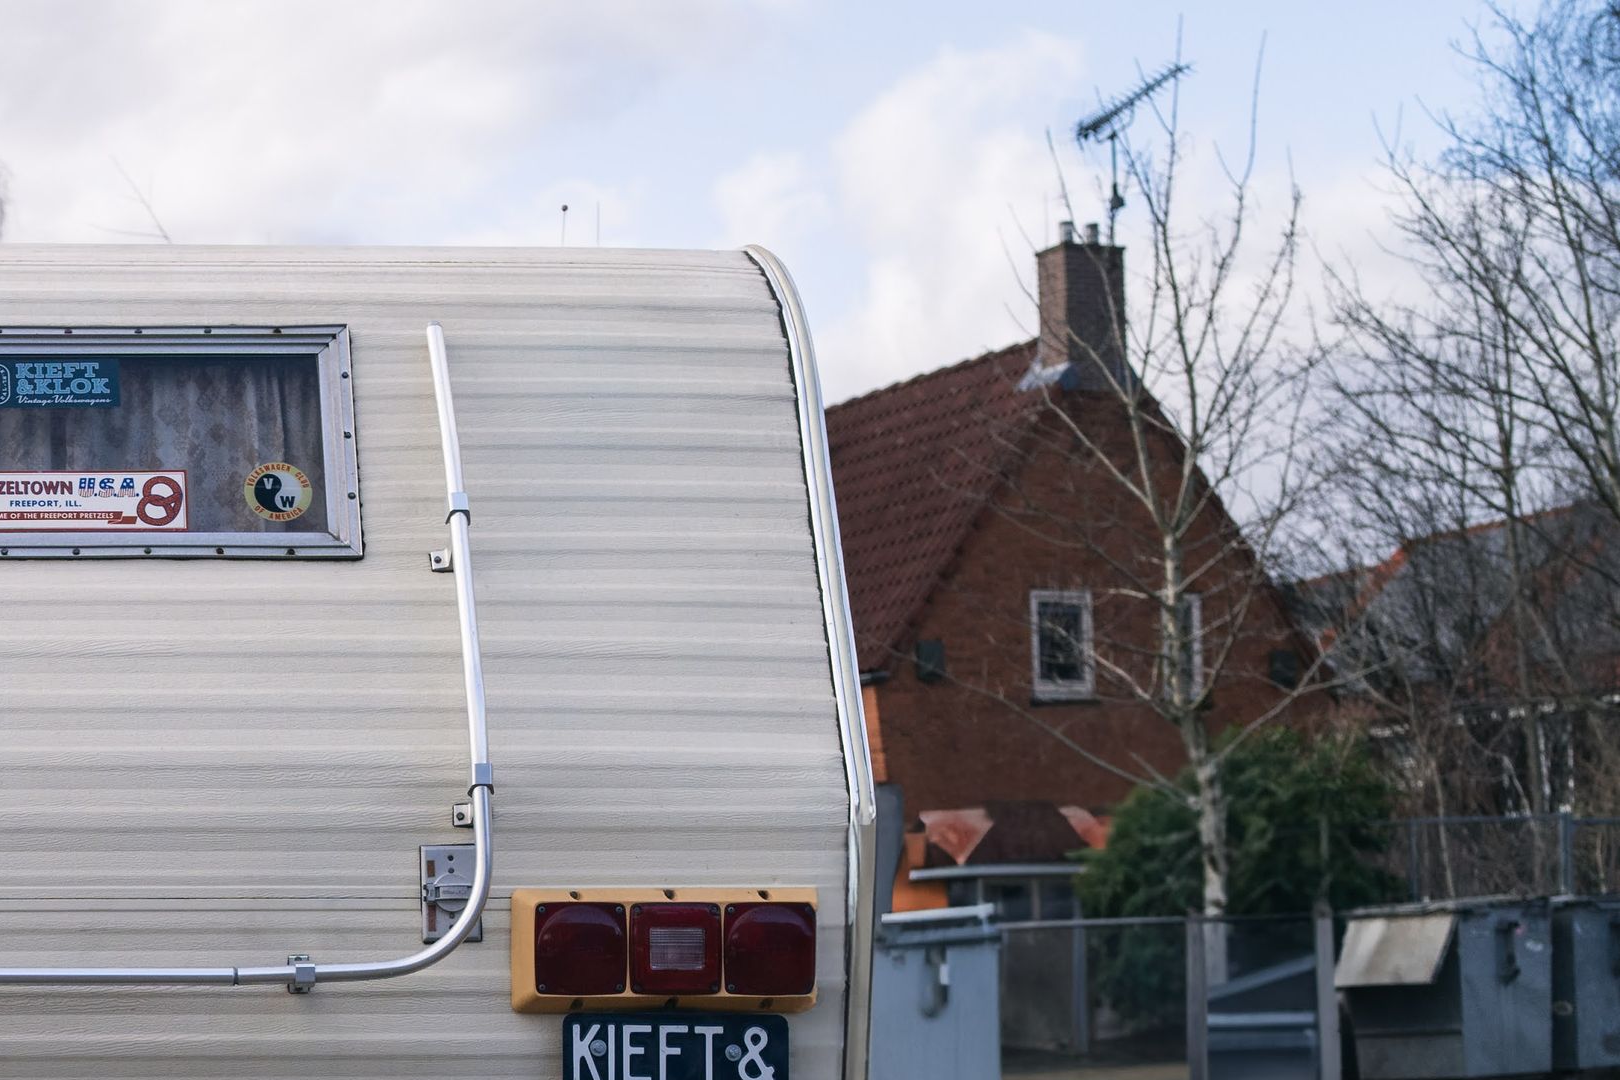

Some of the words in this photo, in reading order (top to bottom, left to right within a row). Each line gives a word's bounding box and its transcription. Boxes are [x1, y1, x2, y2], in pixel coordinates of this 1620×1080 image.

[15, 362, 99, 379] KIEFT
[16, 394, 54, 406] Vintage
[52, 394, 111, 406] Volkswagens
[78, 477, 140, 498] U.S.A.
[9, 500, 62, 508] FREEPORT,
[65, 499, 82, 507] ILL.
[9, 512, 21, 520] OF
[23, 512, 37, 520] THE
[39, 512, 78, 520] FREEPORT
[79, 511, 114, 520] PRETZELS
[268, 507, 304, 520] AMERICA
